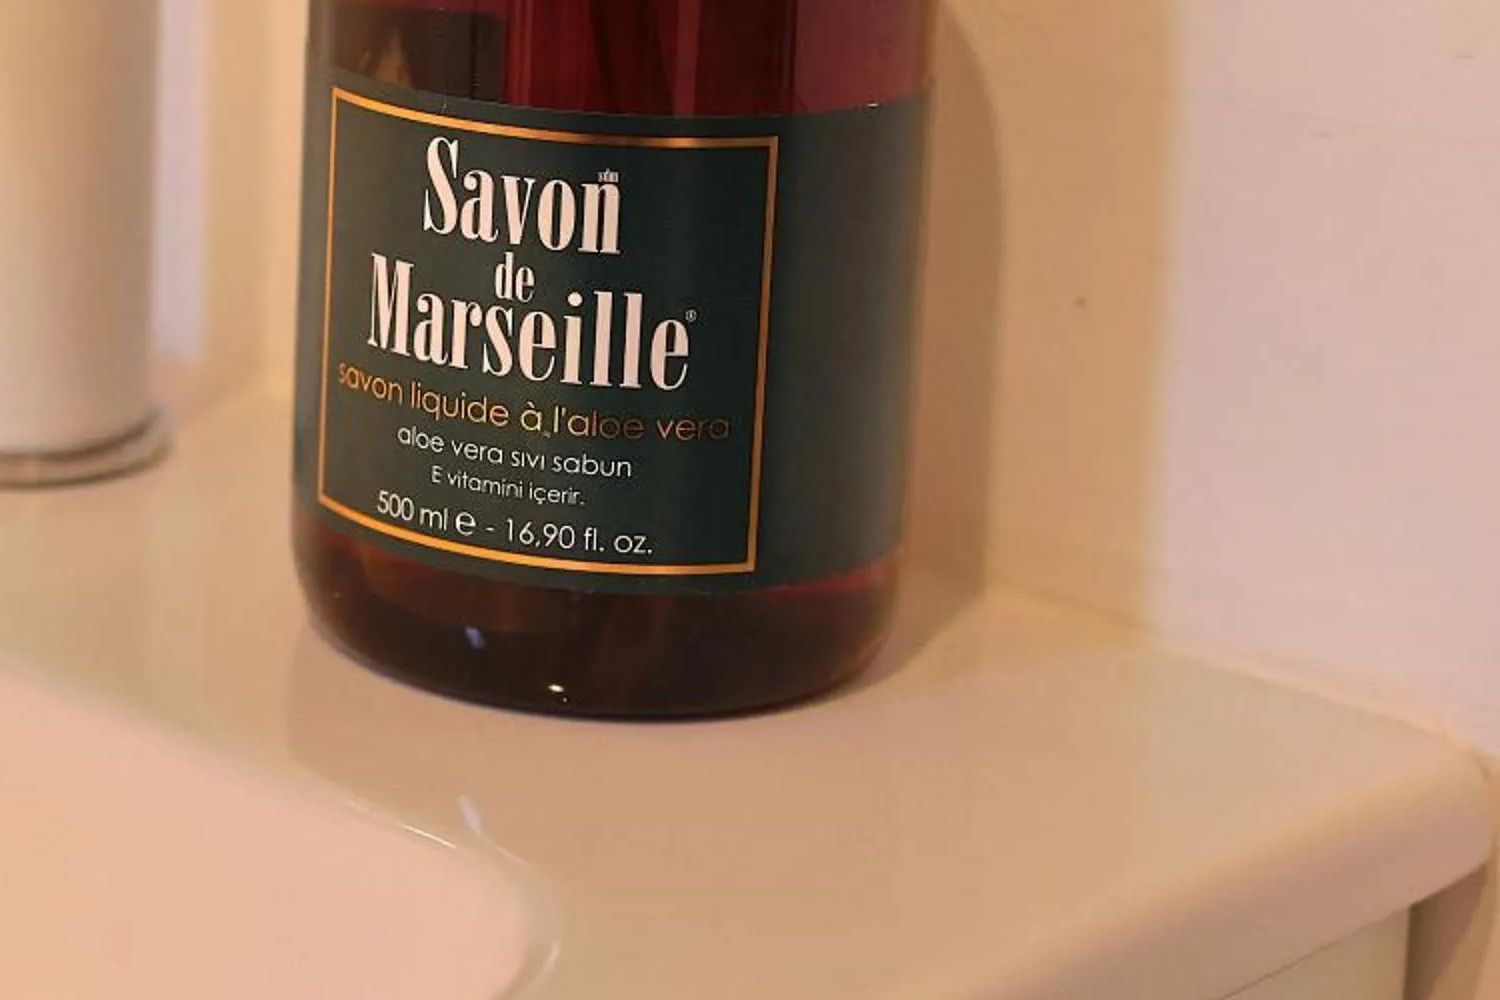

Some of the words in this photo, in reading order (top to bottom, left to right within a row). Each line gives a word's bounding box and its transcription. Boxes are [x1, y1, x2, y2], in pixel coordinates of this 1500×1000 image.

[422, 136, 621, 254] Savon
[494, 251, 535, 303] de
[339, 363, 403, 404] savon
[411, 380, 509, 427] liquide
[520, 402, 542, 431] à
[553, 405, 645, 439] l'aloe
[656, 418, 730, 440] vera
[397, 425, 444, 453] aloe
[451, 440, 503, 464] vera
[551, 453, 632, 477] sabun
[431, 465, 443, 483] E
[447, 469, 524, 499] vitamini
[529, 481, 585, 506] içerir.
[377, 490, 414, 521] 500
[420, 507, 449, 531] ml
[507, 518, 576, 550] 16,90
[584, 527, 605, 552] fl.
[614, 534, 653, 554] oz.
